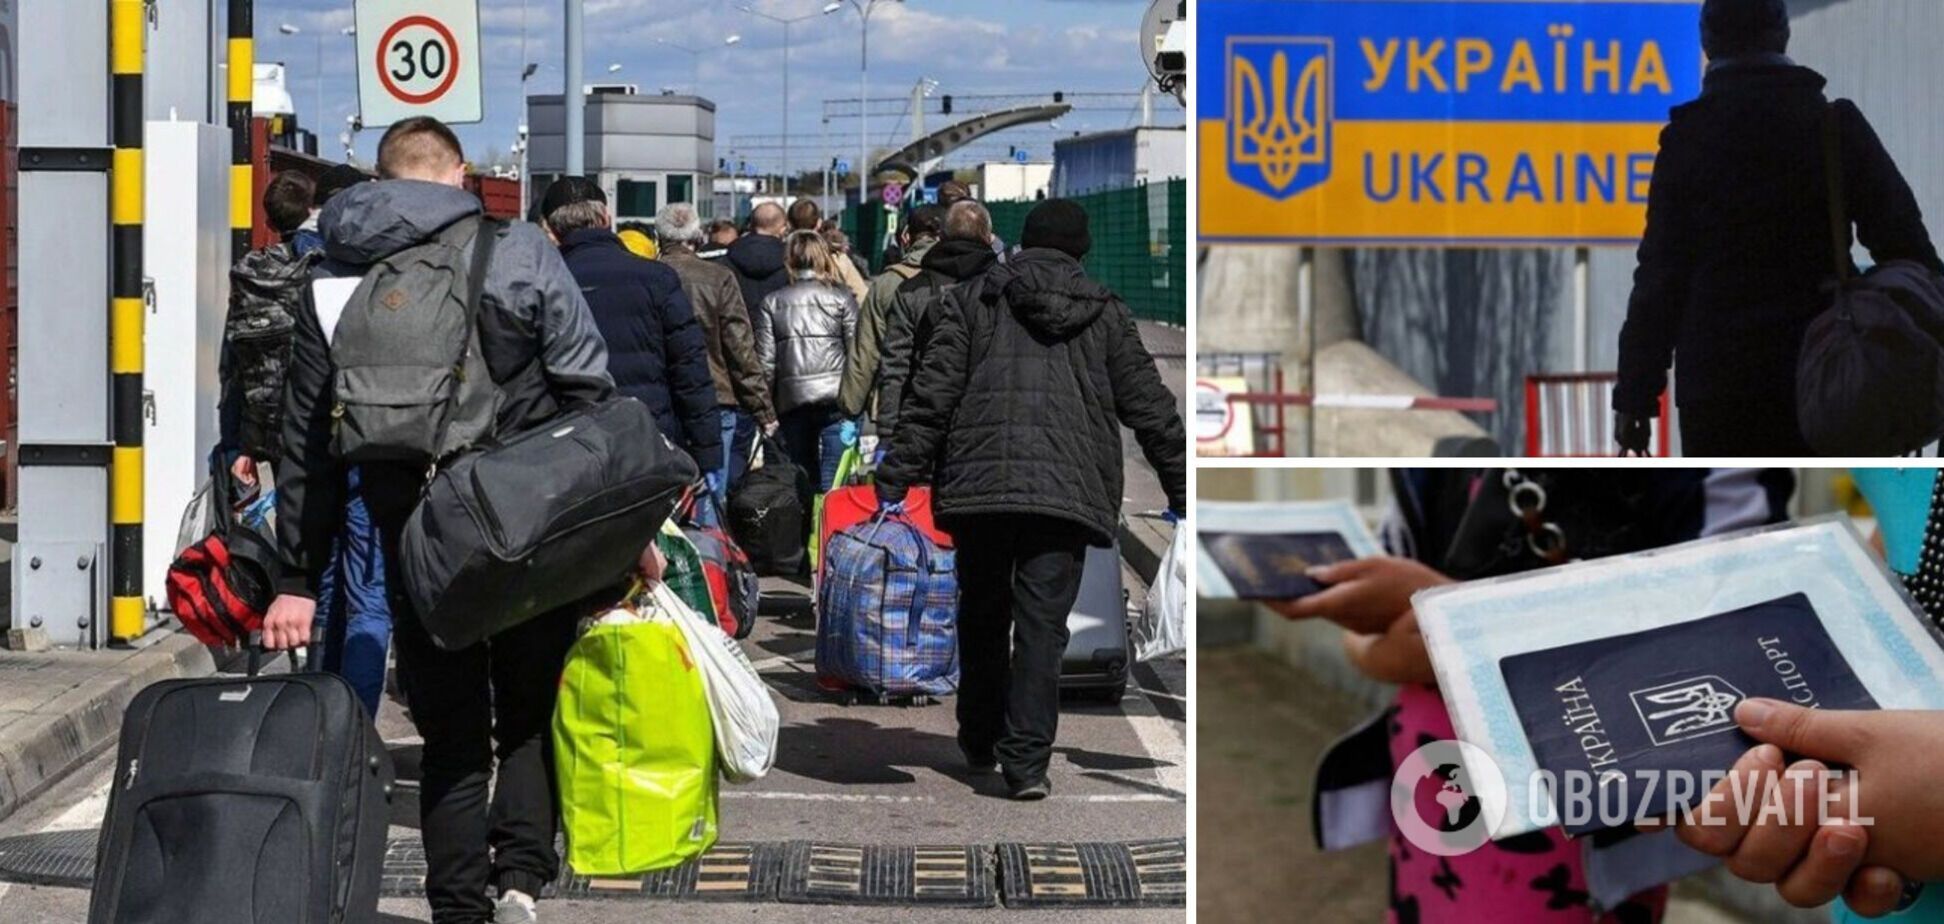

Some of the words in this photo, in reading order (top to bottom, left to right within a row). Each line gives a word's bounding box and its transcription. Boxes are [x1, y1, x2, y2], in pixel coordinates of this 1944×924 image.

[391, 39, 445, 82] 30
[1360, 23, 1672, 93] УКРАЇНА
[1363, 151, 1657, 204] UKRAINE
[1757, 636, 1820, 709] СПОРТ
[1555, 676, 1628, 788] УКРАЇНА
